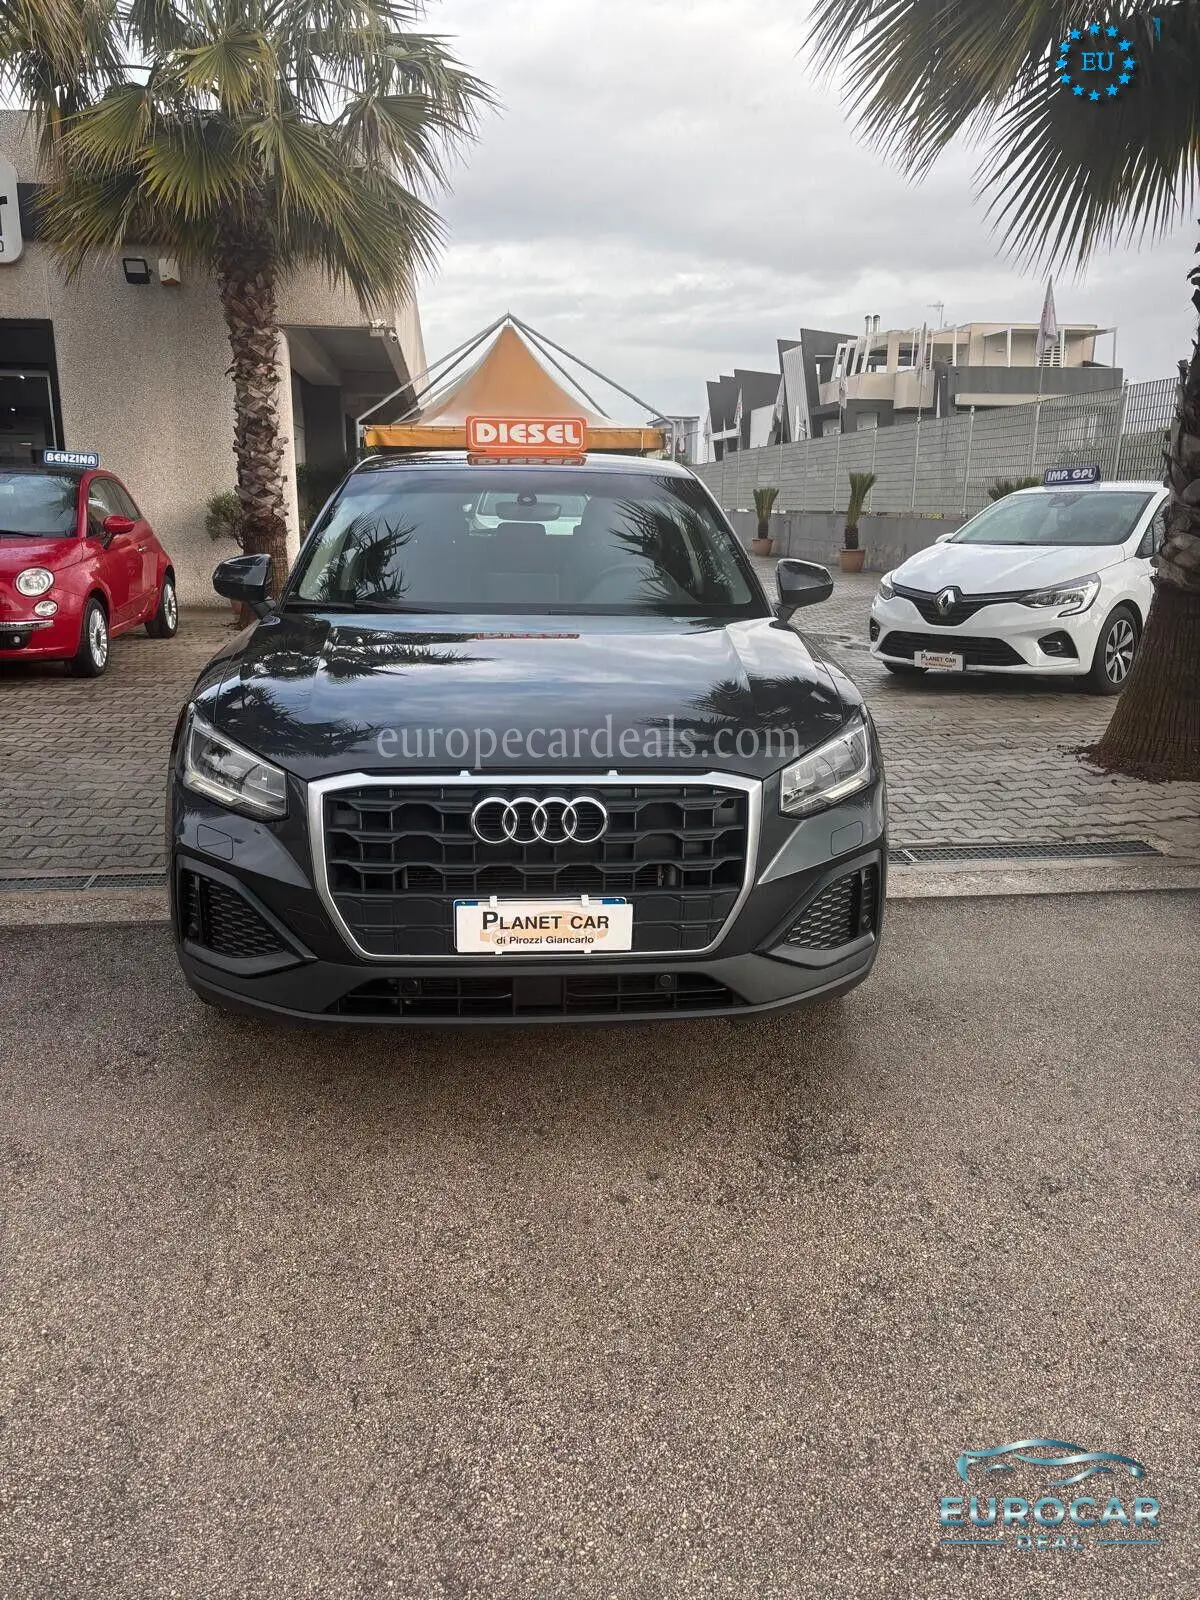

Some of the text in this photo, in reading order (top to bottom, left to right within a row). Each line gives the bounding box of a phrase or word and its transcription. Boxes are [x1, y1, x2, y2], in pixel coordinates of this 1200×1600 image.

[476, 422, 580, 444] DIESEL
[46, 452, 96, 465] BENZINA
[1047, 468, 1094, 482] IMP. GPL
[482, 911, 609, 930] PLANET CAR
[496, 935, 594, 945] di Pirozzi Giancarlo
